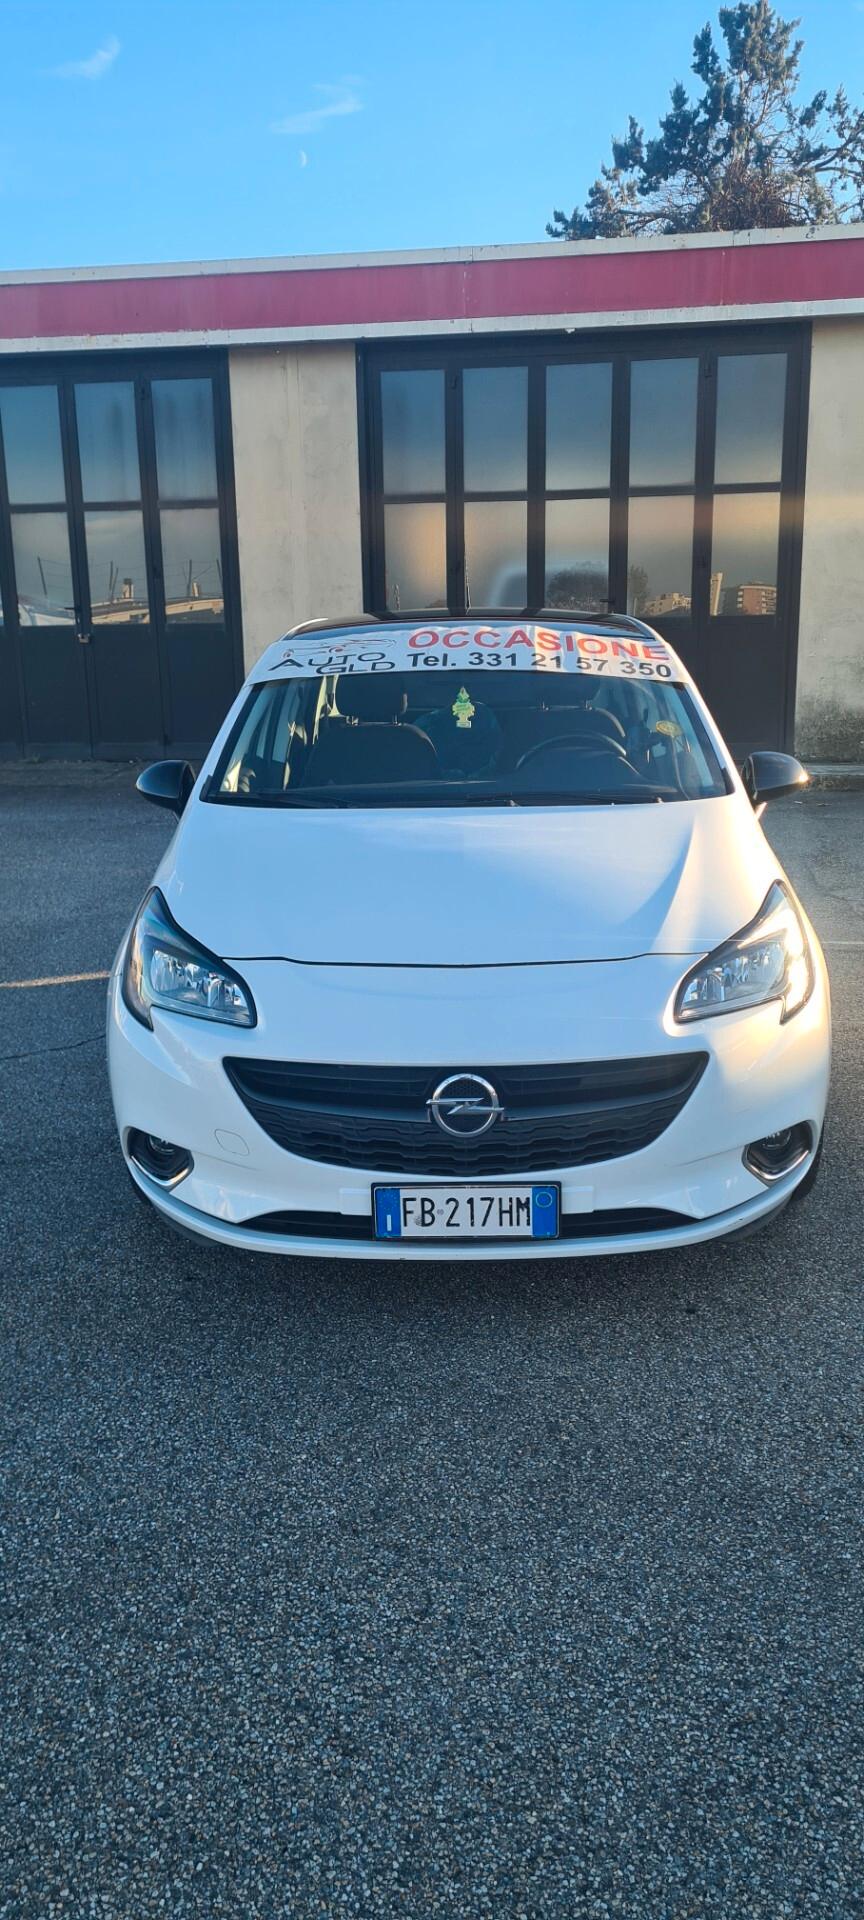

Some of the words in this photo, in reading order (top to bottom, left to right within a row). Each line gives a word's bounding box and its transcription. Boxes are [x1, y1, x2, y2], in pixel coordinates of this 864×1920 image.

[407, 629, 671, 661] OCCASIONE
[267, 652, 387, 672] AUTO
[315, 661, 397, 675] GLD
[407, 652, 456, 667] Tel.
[468, 651, 517, 666] 331
[531, 653, 561, 668] 21
[576, 656, 609, 671] 57
[619, 661, 672, 678] 350
